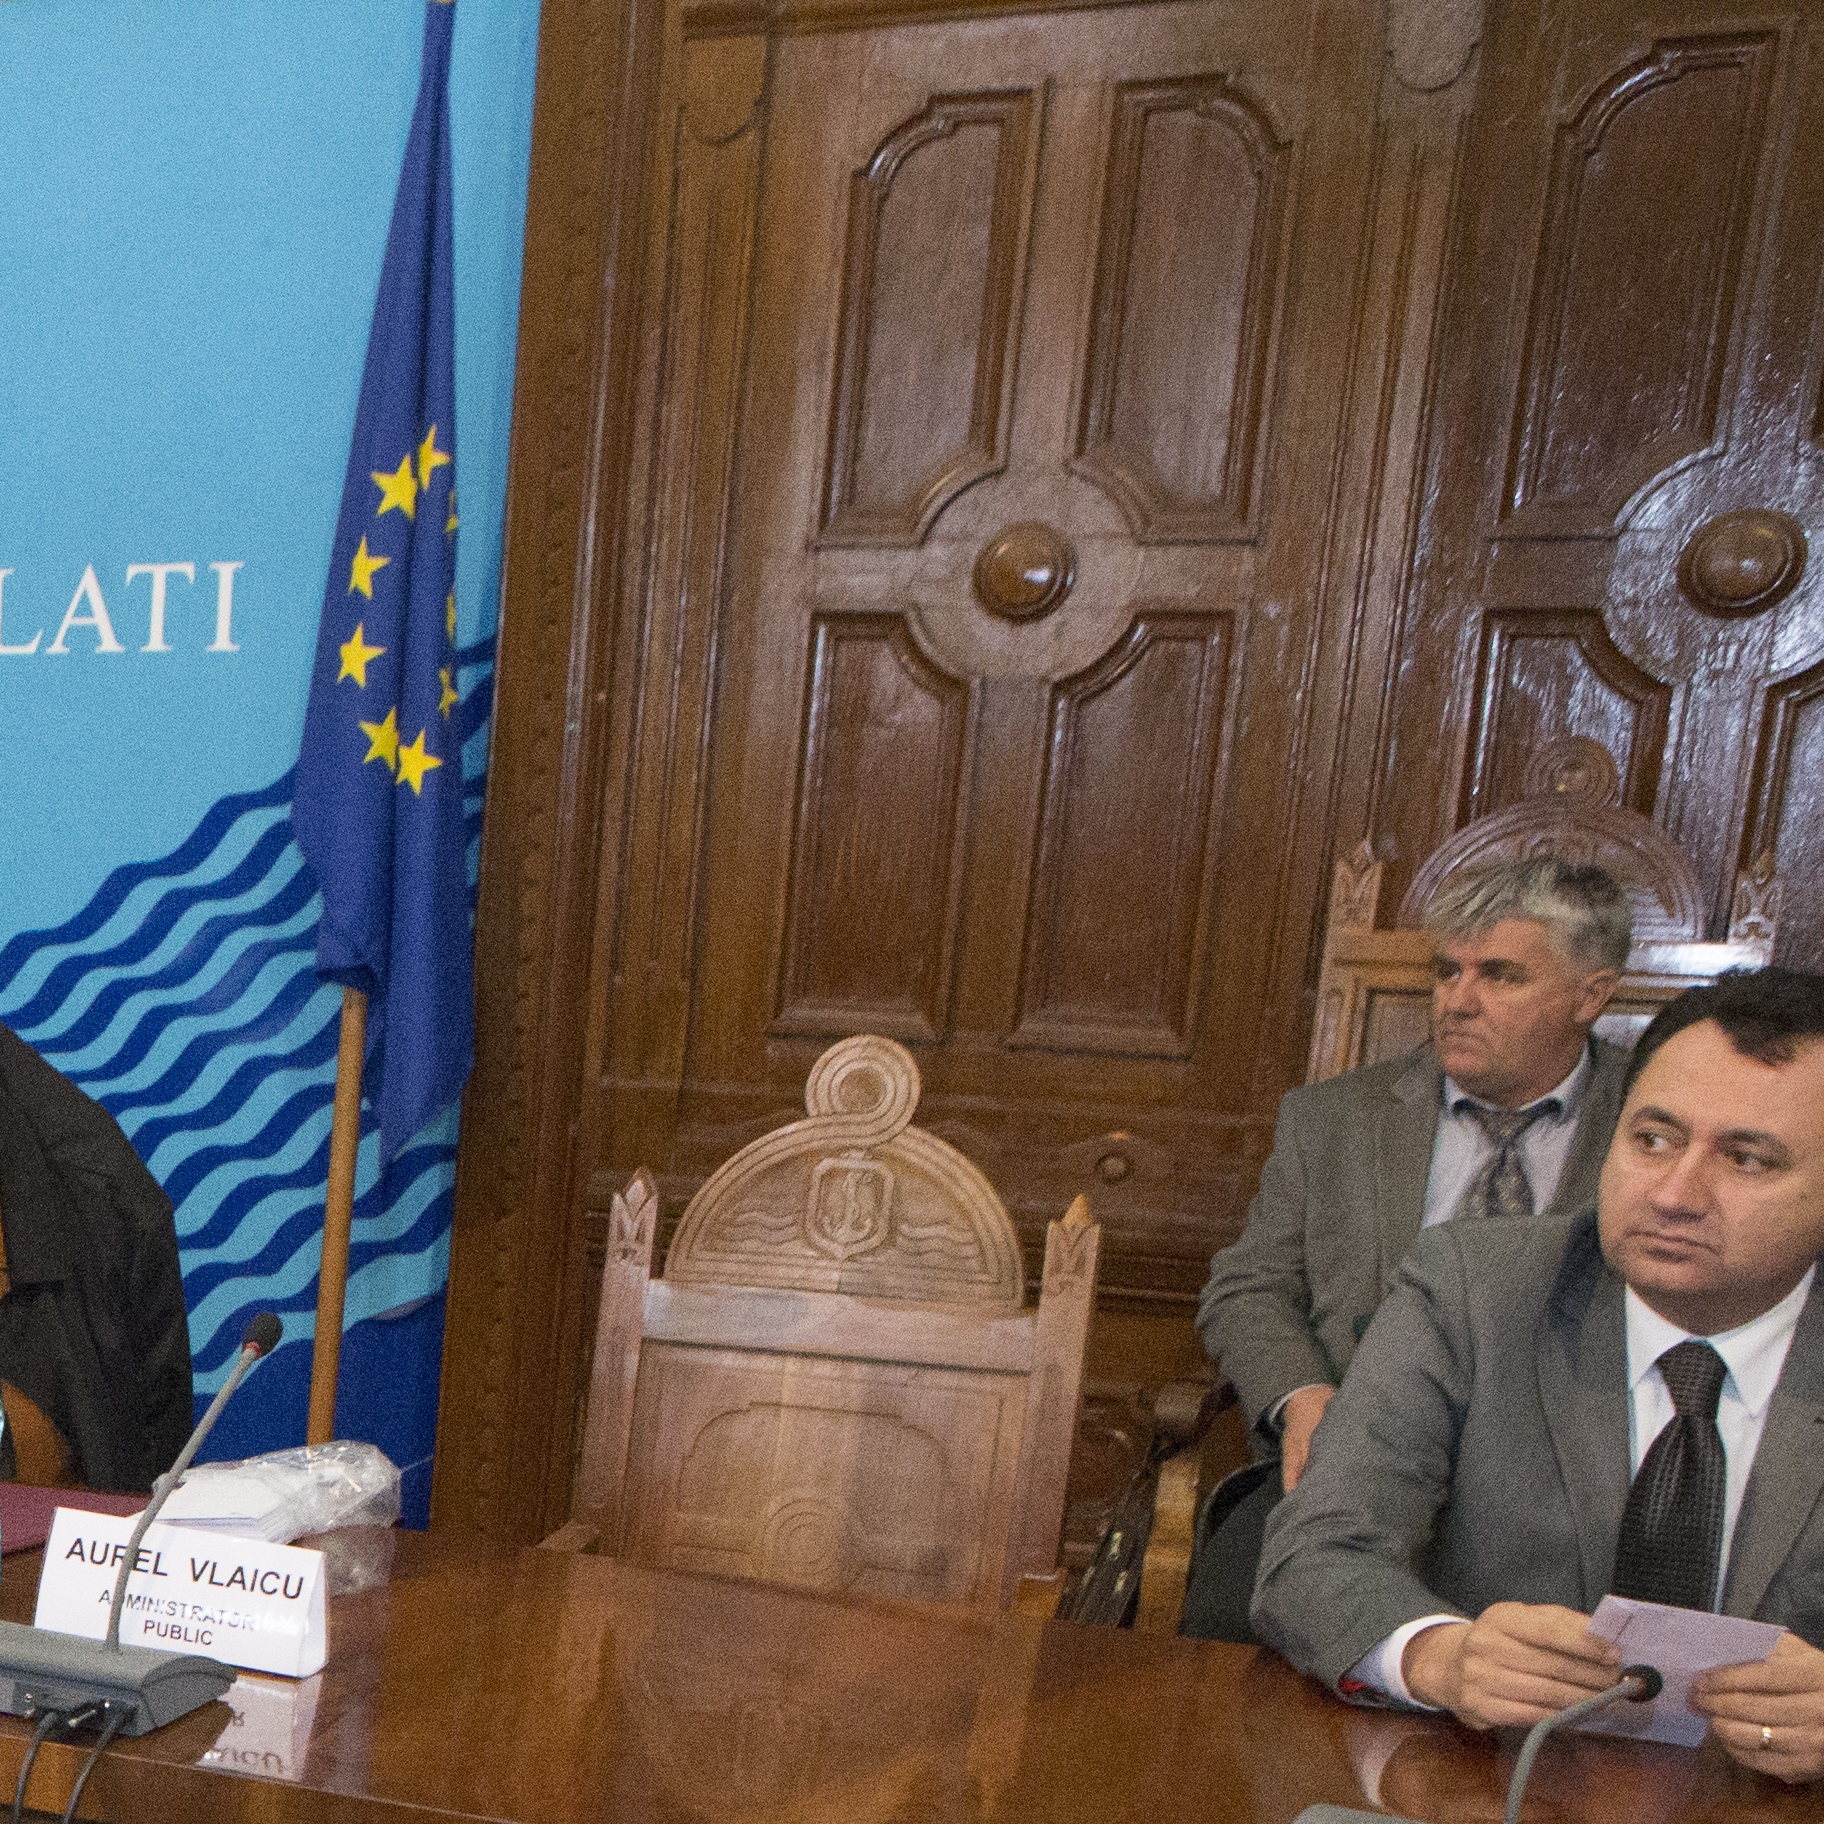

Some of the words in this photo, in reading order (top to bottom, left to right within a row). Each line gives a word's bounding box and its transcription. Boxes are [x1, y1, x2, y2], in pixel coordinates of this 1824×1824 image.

[65, 1537, 168, 1577] AUREL
[190, 1557, 304, 1600] VLAICU
[98, 1589, 255, 1631] AMINISTRATOR
[143, 1620, 213, 1645] PUBLIC
